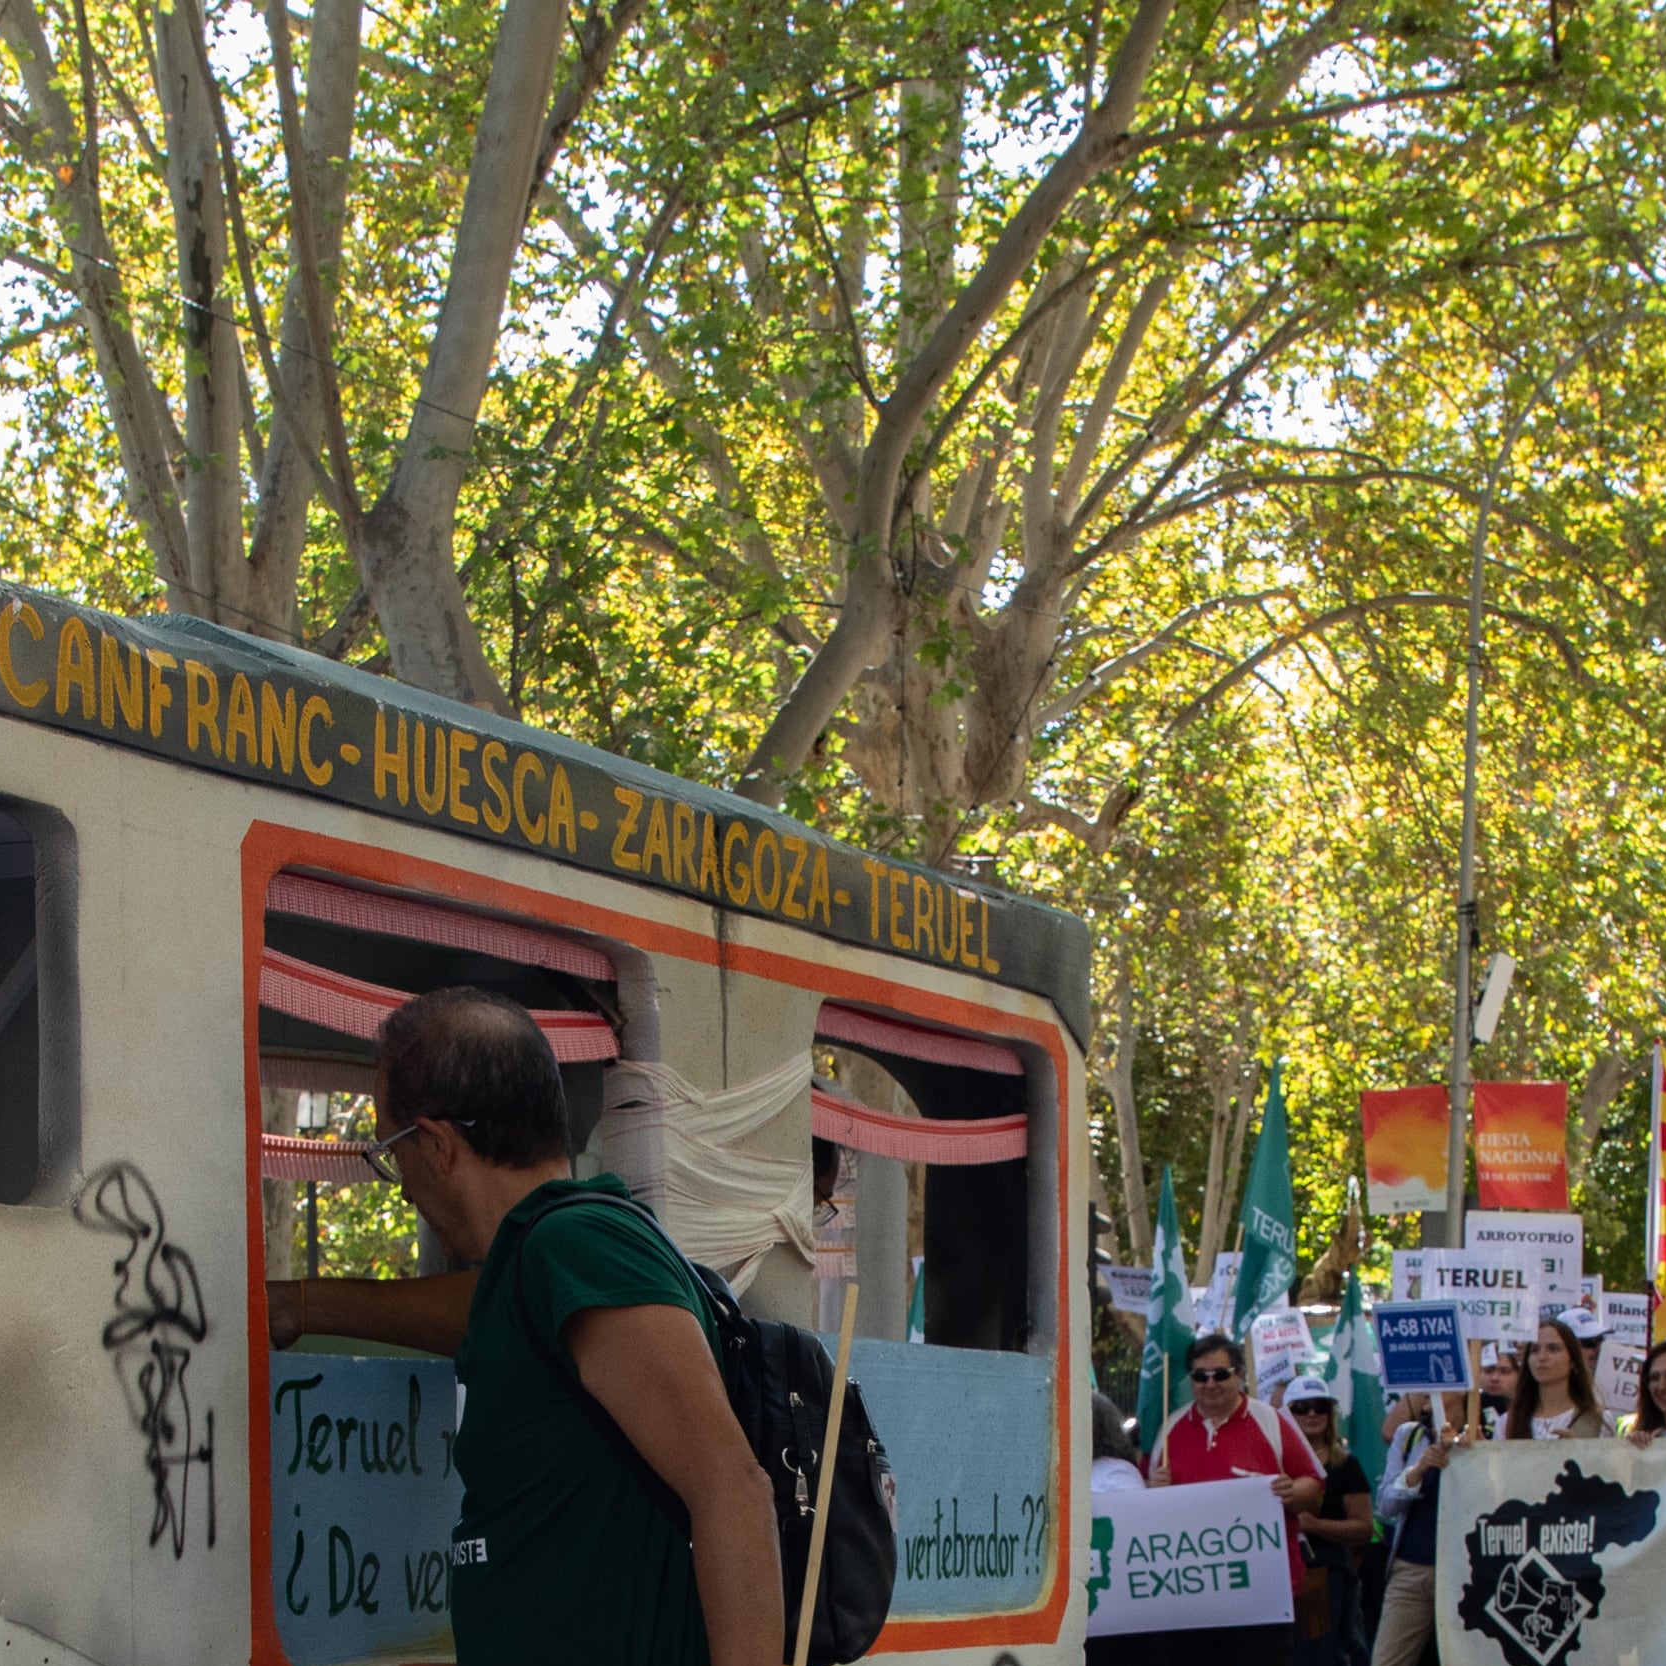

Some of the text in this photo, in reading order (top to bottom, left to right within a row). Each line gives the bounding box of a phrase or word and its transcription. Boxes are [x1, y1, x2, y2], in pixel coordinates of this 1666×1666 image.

[863, 860, 1001, 975] TERUEL
[1478, 1133, 1531, 1147] FIESTA
[1479, 1150, 1560, 1165] NACIONAL
[1251, 1205, 1295, 1258] TERU
[1476, 1229, 1574, 1245] ARROYOFRÍO
[1436, 1267, 1529, 1289] TERUEL
[1460, 1300, 1520, 1318] XISTE!
[1381, 1316, 1453, 1338] A-68 ¡YA!
[275, 1373, 423, 1476] Teruel
[1126, 1516, 1281, 1565] ARAGÓN
[1477, 1515, 1596, 1557] Teruel existe!
[452, 1537, 488, 1567] XISTE
[1128, 1560, 1250, 1599] EXISTE
